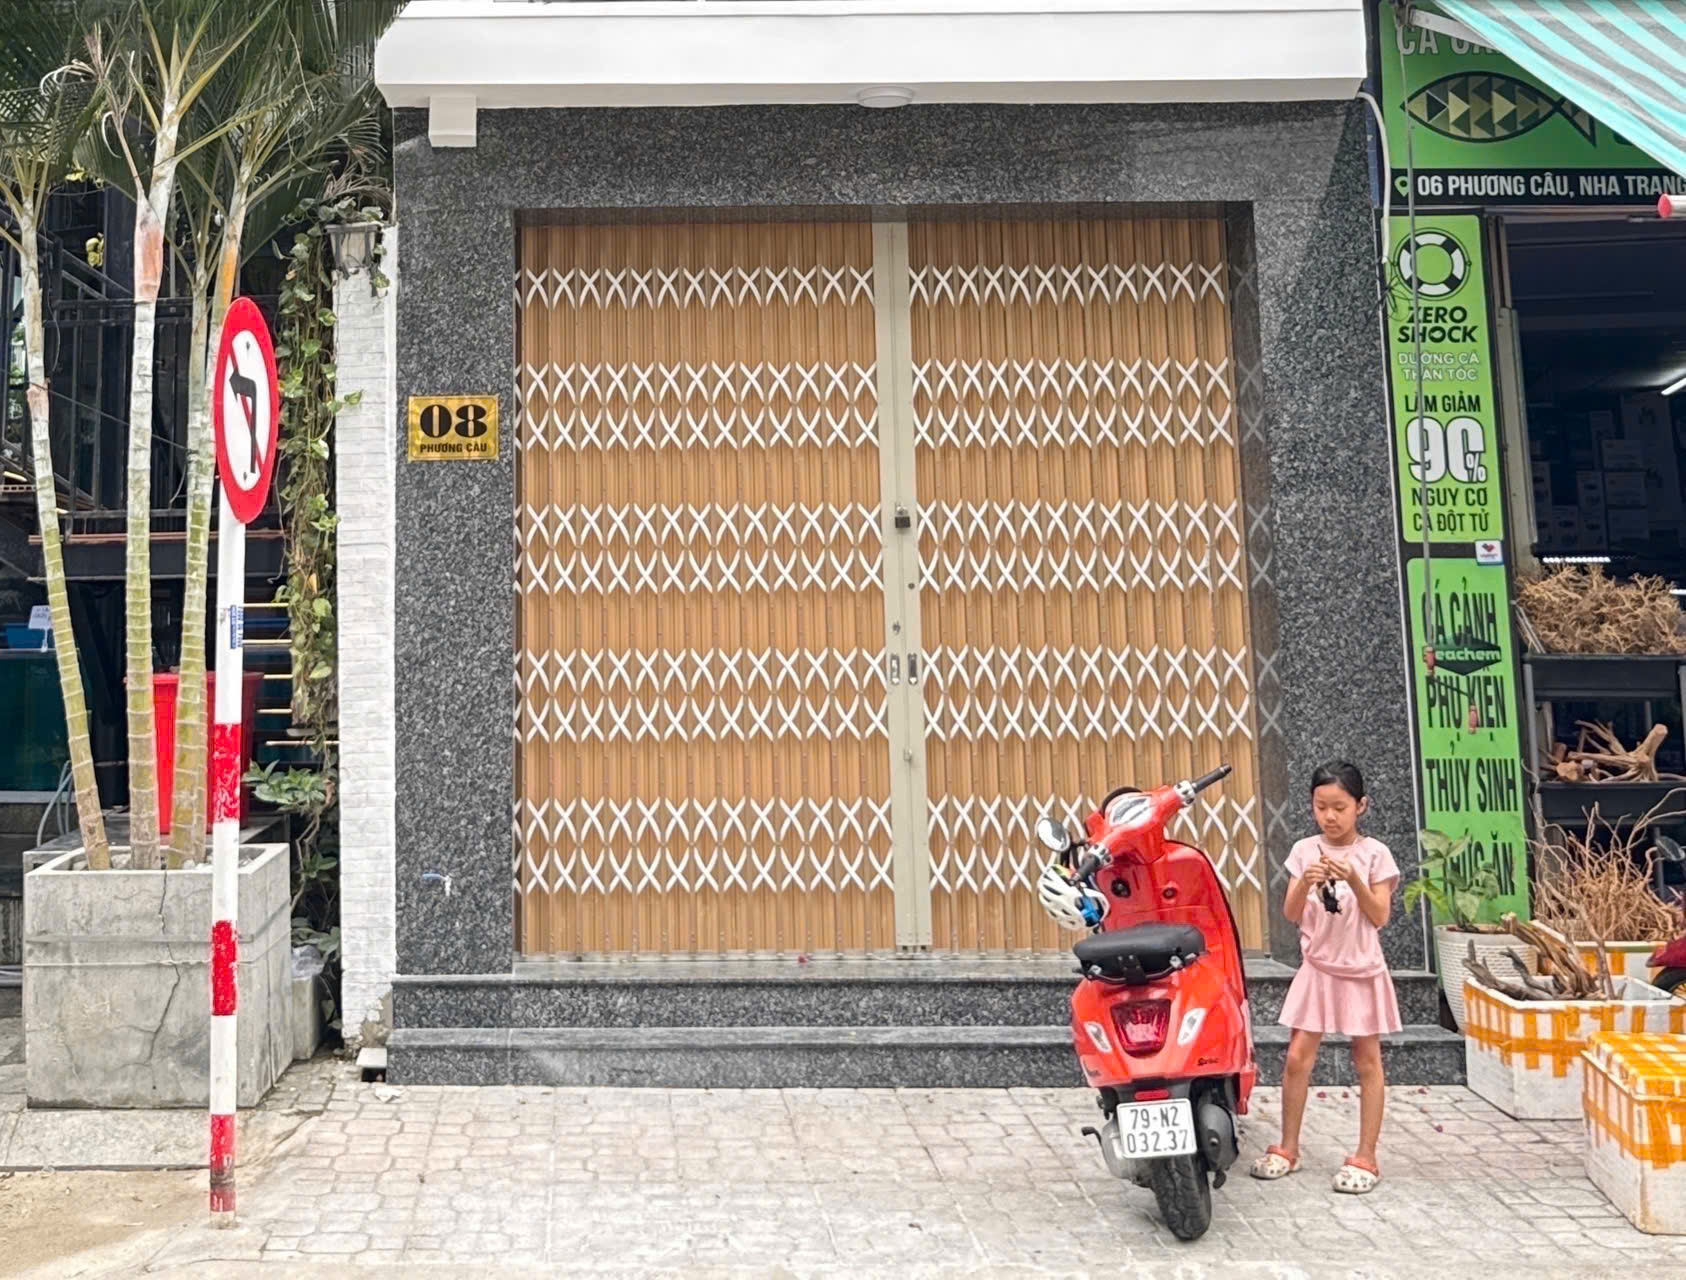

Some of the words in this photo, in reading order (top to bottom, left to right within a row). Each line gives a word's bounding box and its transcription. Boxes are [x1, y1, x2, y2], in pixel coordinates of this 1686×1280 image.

[1417, 175, 1443, 196] 06
[1447, 174, 1526, 196] PHƯƠNG
[1530, 172, 1575, 198] CÂU,
[1579, 175, 1621, 196] NHA
[1624, 175, 1686, 196] TRANG
[1406, 305, 1468, 324] ZERO
[1397, 325, 1479, 343] SHOCK
[1441, 390, 1481, 413] GIẢM
[420, 404, 487, 438] 08
[1411, 487, 1459, 506] NGUY
[1465, 487, 1488, 506] CƠ
[1436, 509, 1466, 535] ĐỘT
[1469, 508, 1489, 532] TỬ
[1424, 648, 1501, 661] eachem
[1425, 741, 1470, 812] THỦY
[1476, 757, 1518, 812] SINH
[1127, 1129, 1188, 1153] 032.37
